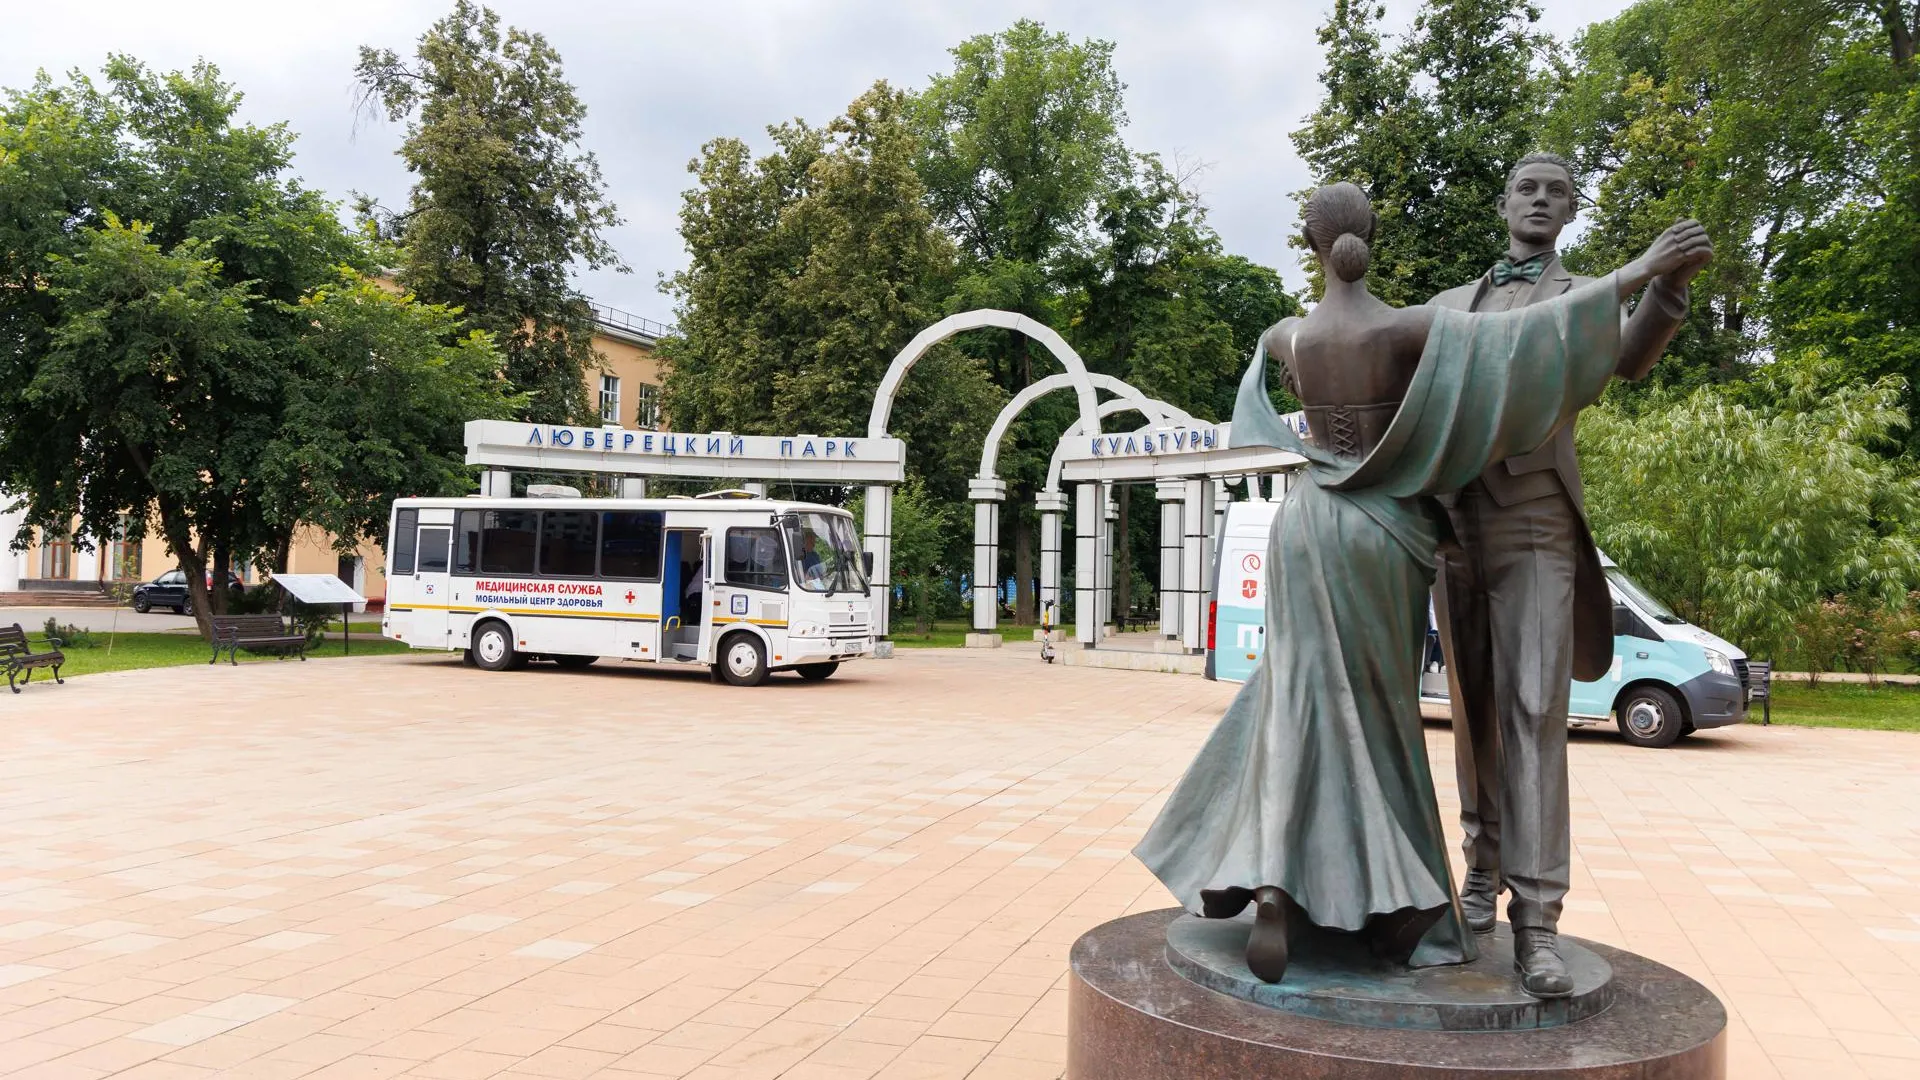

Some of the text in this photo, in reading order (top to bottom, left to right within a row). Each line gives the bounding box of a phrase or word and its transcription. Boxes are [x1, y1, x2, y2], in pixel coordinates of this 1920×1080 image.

[529, 427, 857, 457] ЛЮБЕРЕЦКИЙ ПАРК
[1092, 429, 1217, 455] КУЛЬТУРЫ
[475, 580, 603, 596] МЕДИЦИНСКАЯ СЛУЖБА
[475, 594, 603, 608] МОБИЛЬНЫЙ ЦЕНТР ЗДОРОВЬЯ
